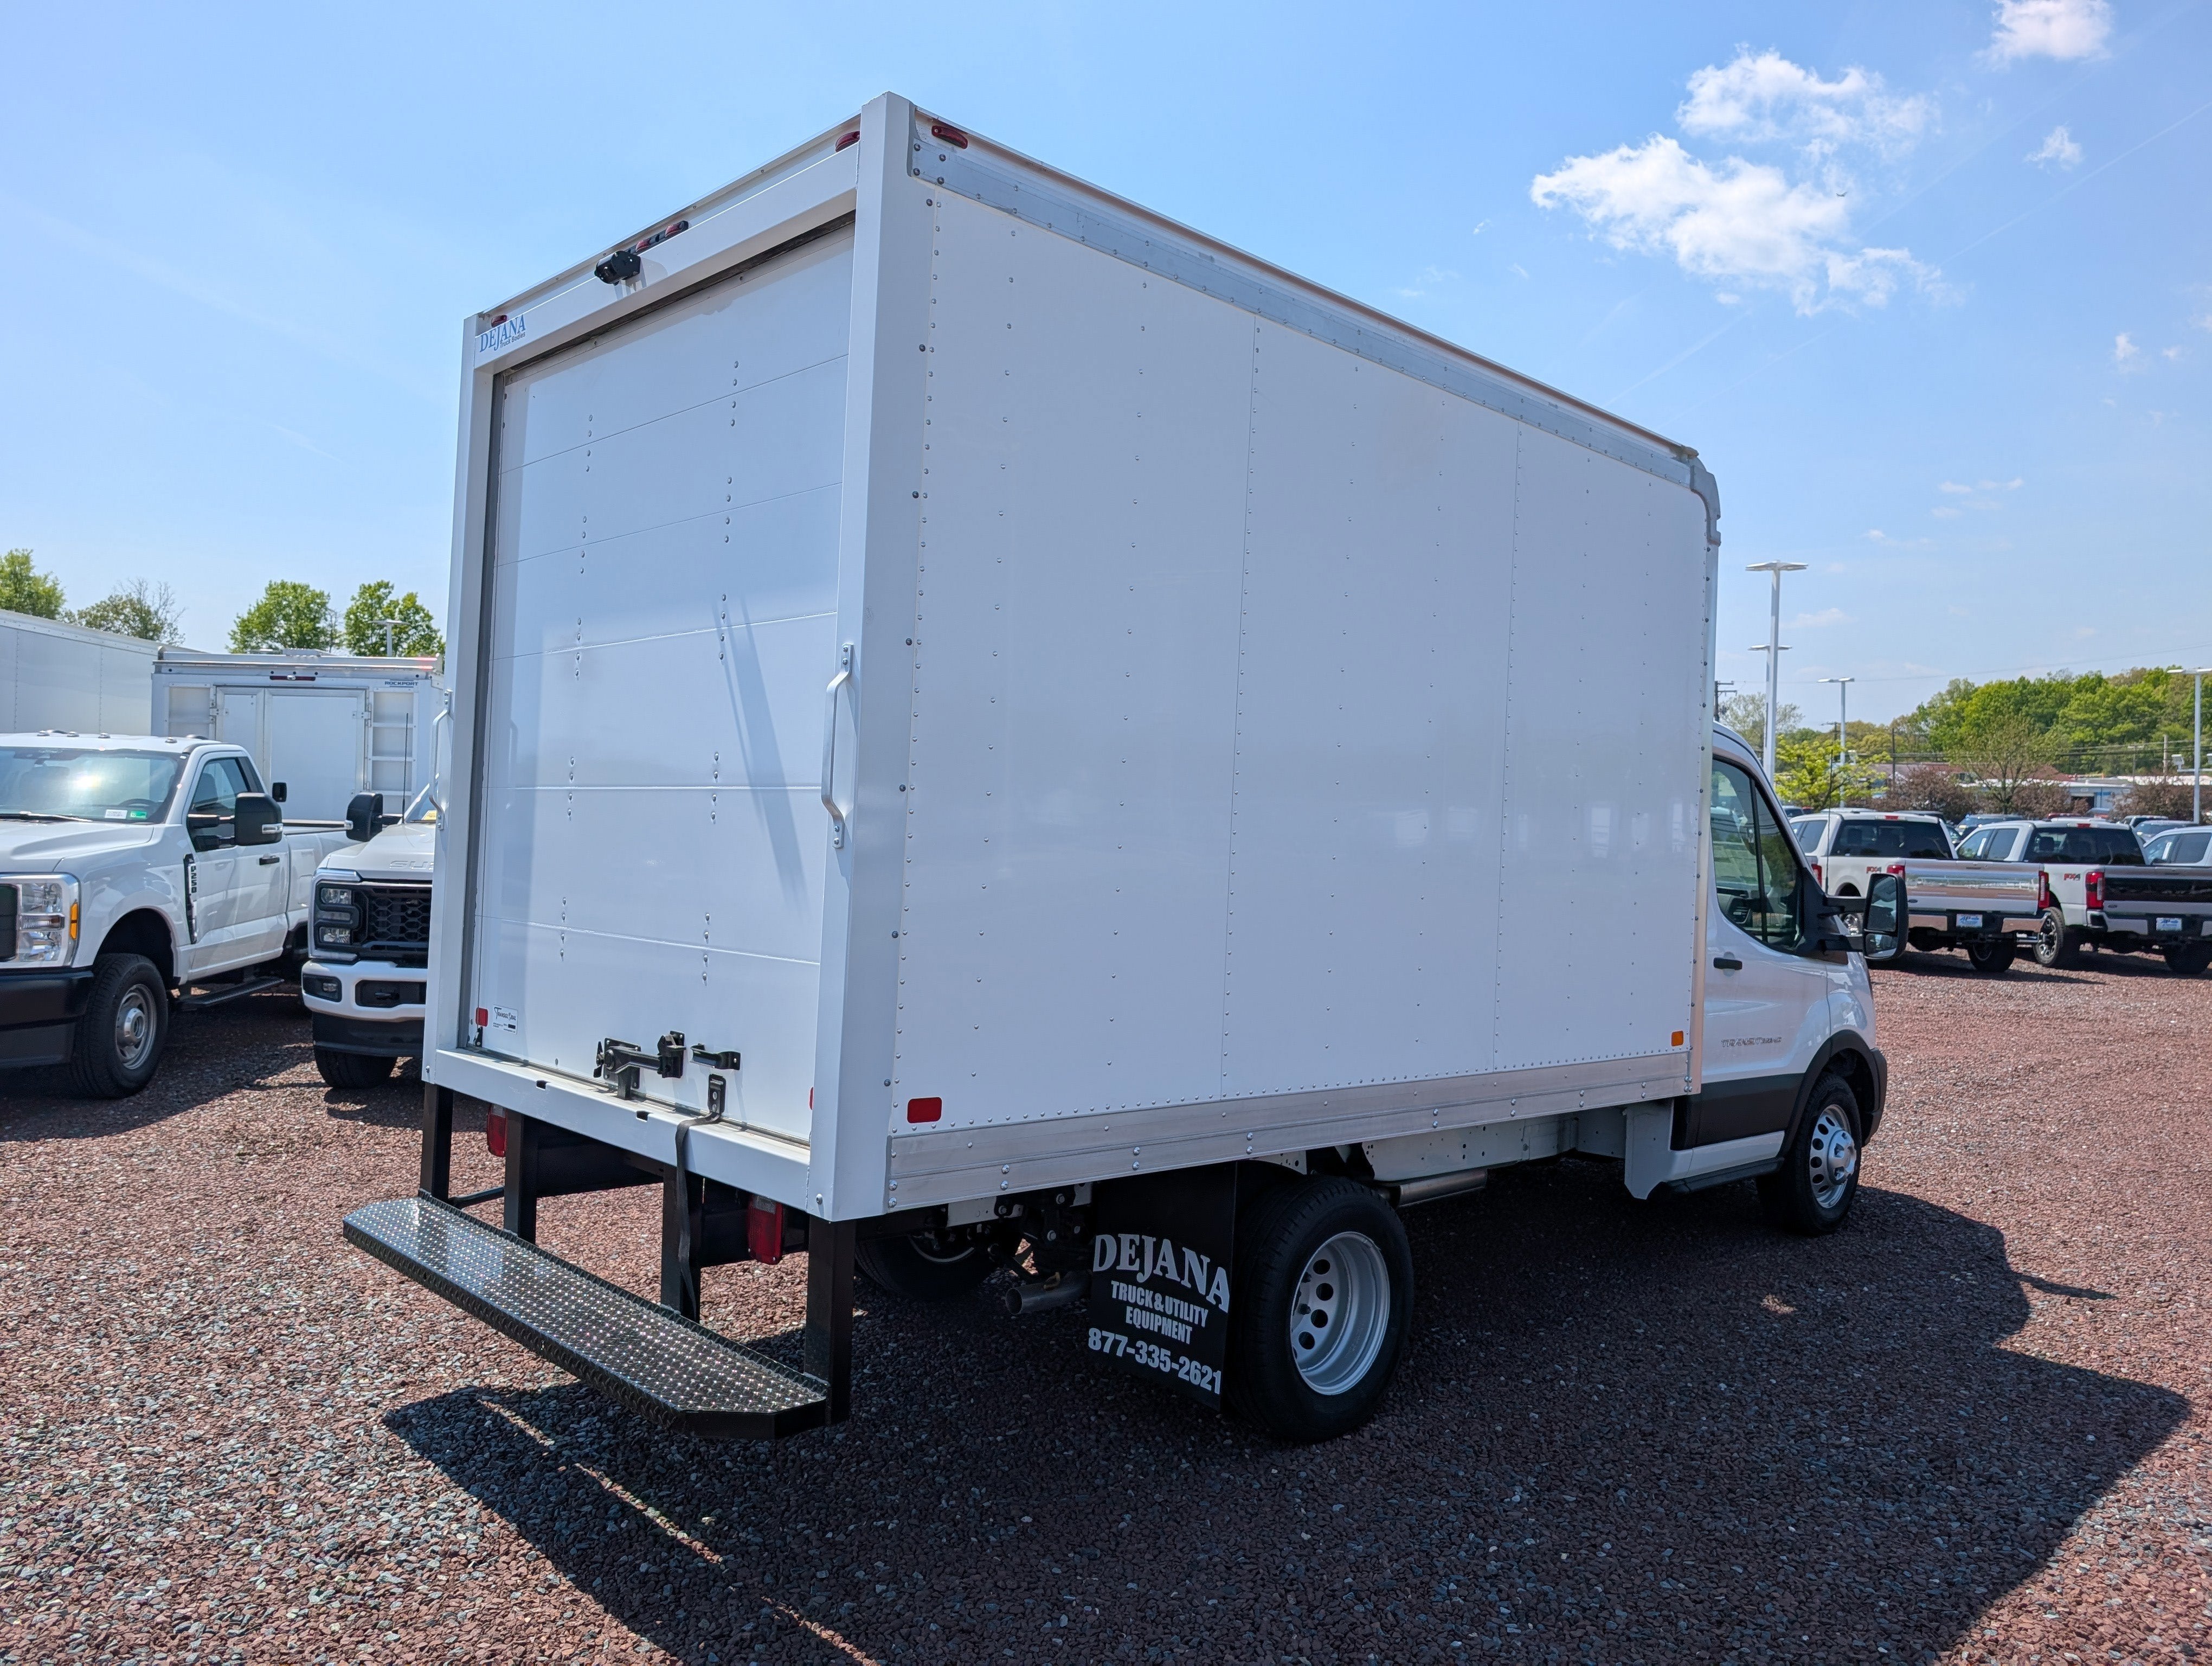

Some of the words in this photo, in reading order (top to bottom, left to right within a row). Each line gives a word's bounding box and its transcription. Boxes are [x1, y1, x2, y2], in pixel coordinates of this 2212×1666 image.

[479, 315, 526, 353] DEJANA
[500, 338, 511, 348] Truck
[511, 331, 526, 343] Bodies
[389, 860, 434, 871] SU
[1092, 1233, 1231, 1313] DEJANA
[1125, 1306, 1193, 1345] EQUIPMENT
[1088, 1328, 1221, 1394] 877-335-2621
